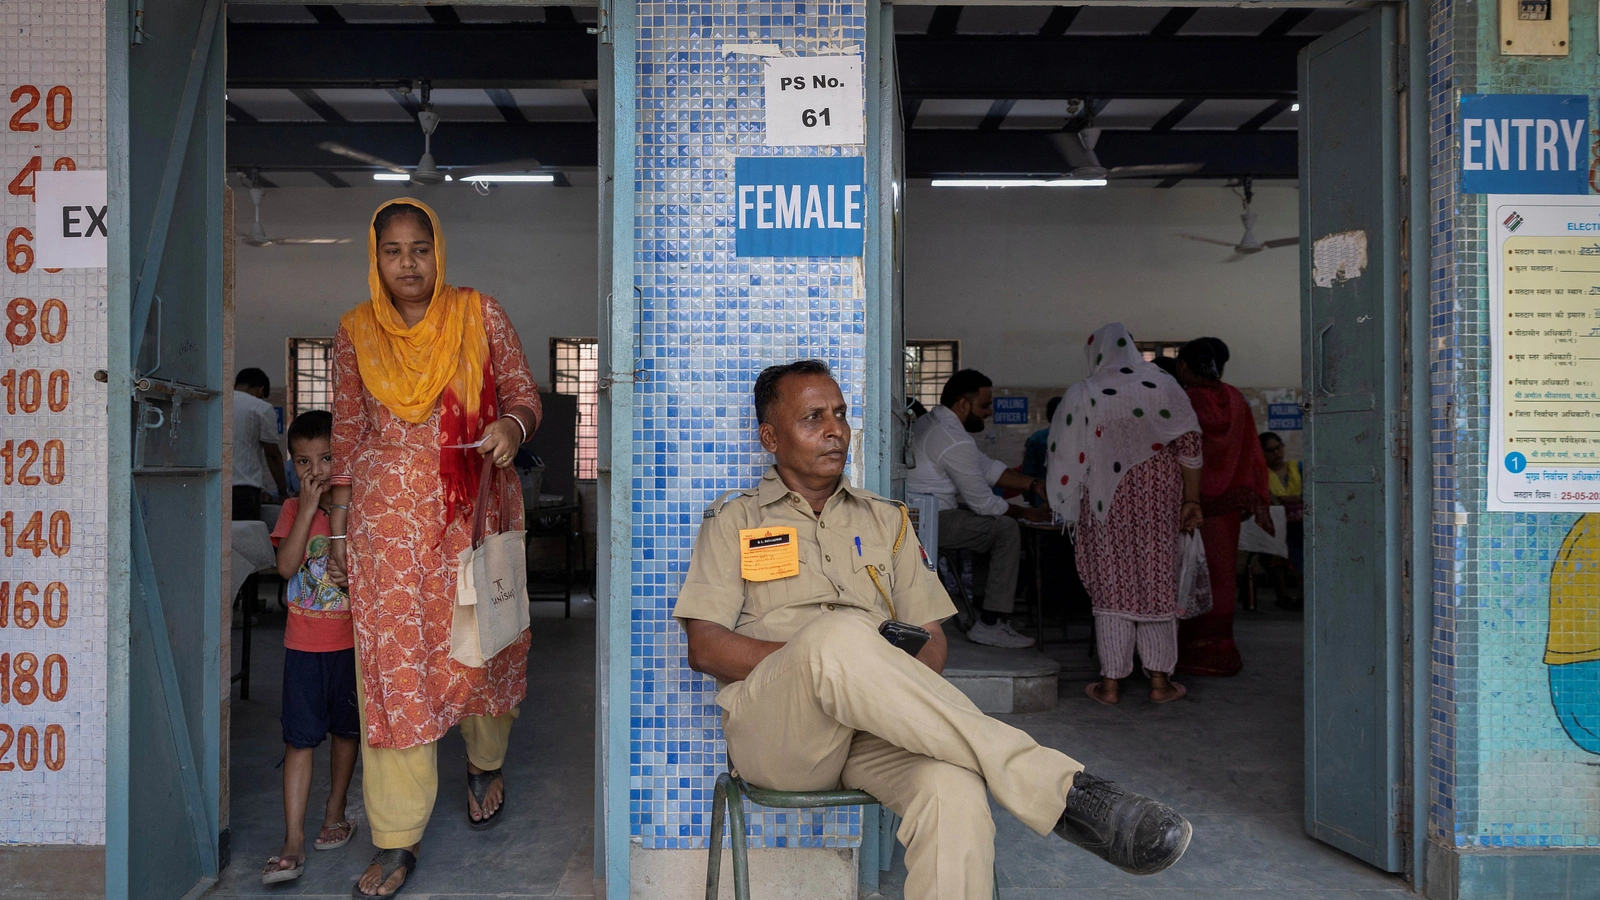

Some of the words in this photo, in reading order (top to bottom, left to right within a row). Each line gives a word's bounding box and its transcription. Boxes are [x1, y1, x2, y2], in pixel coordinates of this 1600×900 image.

[780, 75, 806, 91] PS
[813, 74, 845, 89] No.
[8, 84, 73, 132] 20
[801, 107, 831, 128] 61
[1463, 118, 1586, 171] ENTRY
[738, 184, 861, 229] FEMALE
[1514, 265, 1528, 273] कुल
[5, 297, 68, 347] 80
[1554, 310, 1564, 318] की
[0, 368, 70, 415] 100
[1515, 378, 1538, 386] निर्वाचन
[1541, 378, 1570, 386] अधिकारी
[997, 399, 1025, 409] POLLING
[1270, 405, 1299, 415] POLLING
[994, 412, 1021, 422] OFFICER
[1269, 418, 1295, 428] OFFICER
[0, 439, 65, 486] 120
[1511, 456, 1518, 470] 1
[1525, 472, 1540, 484] मुख्य
[1543, 470, 1568, 481] निर्वाचन
[1535, 489, 1551, 499] दिवस
[0, 510, 72, 558] 140
[0, 581, 68, 629] 160
[0, 652, 68, 705] 180
[0, 724, 66, 771] 200
